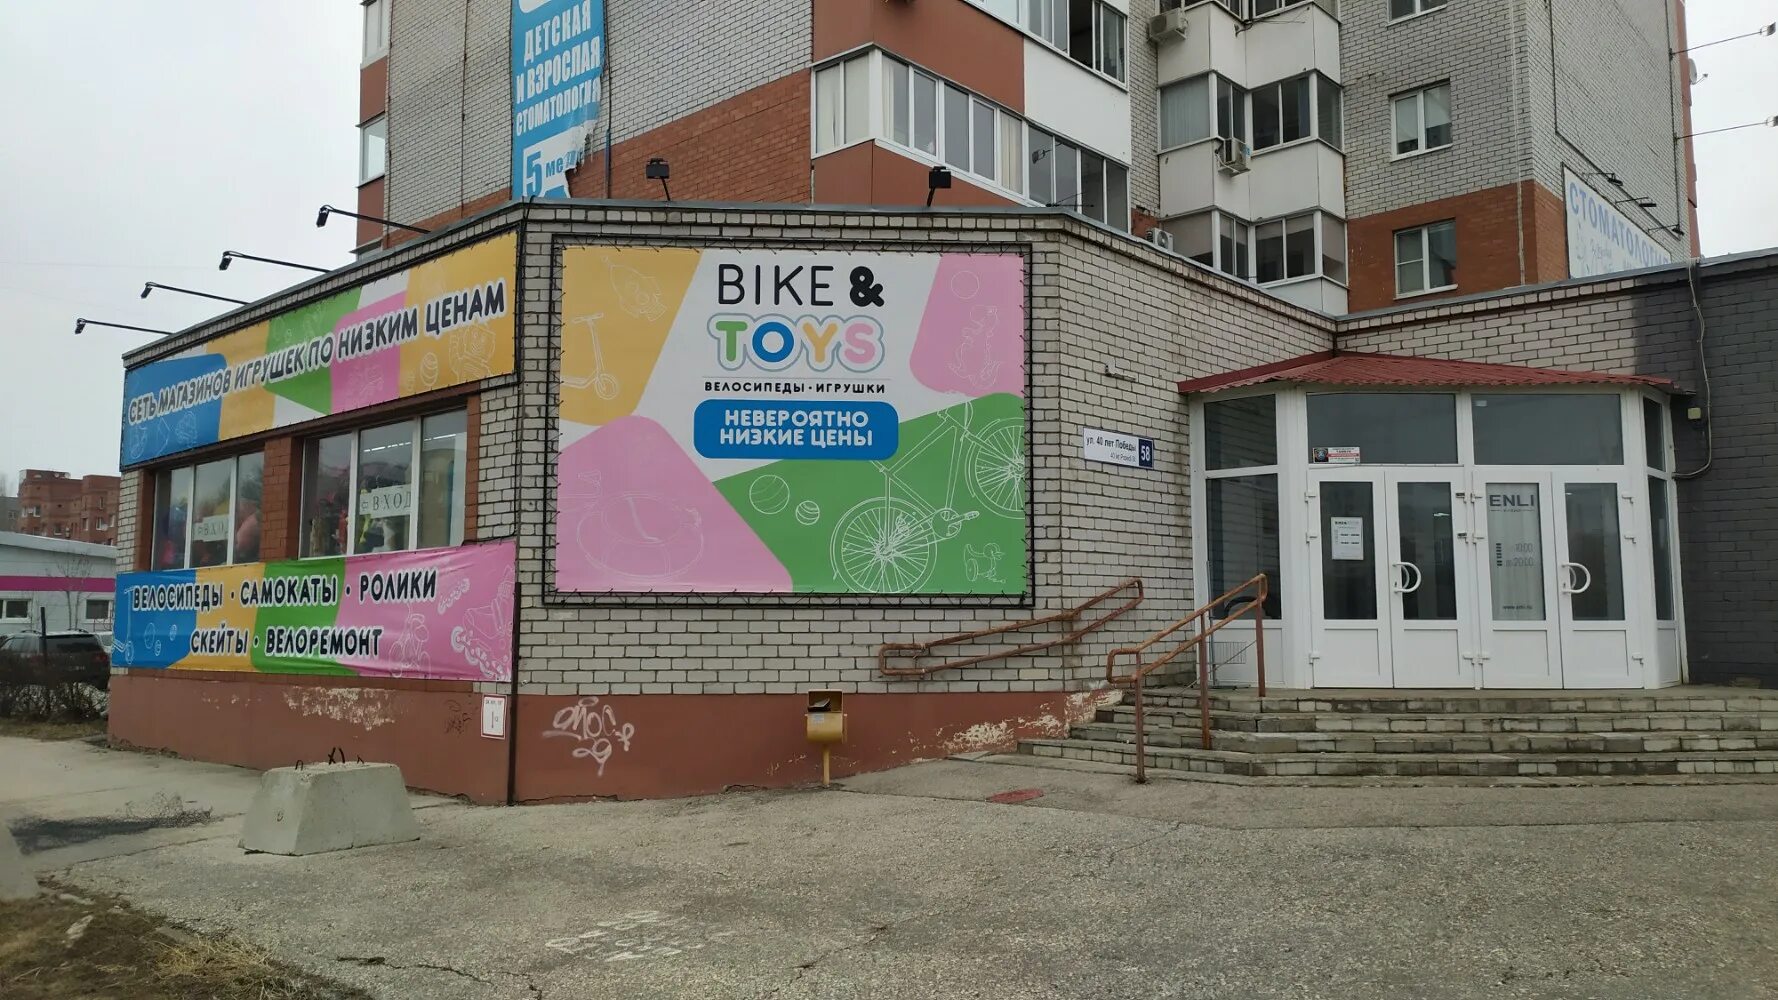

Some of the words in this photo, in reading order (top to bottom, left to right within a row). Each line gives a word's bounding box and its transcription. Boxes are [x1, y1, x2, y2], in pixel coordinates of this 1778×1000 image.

[524, 0, 591, 67] ДЕТСКАЯ
[516, 73, 524, 104] И
[527, 36, 600, 99] ВЗРОСЛАЯ
[516, 76, 601, 137] СТОМАТОЛОГИЯ
[526, 150, 542, 198] 5
[718, 264, 834, 306] BIKE
[850, 266, 885, 307] &
[129, 396, 156, 424] СЕТЬ
[158, 369, 231, 413] МАГАЗИНОВ
[234, 342, 305, 389] ИГРУШЕК
[308, 337, 333, 368] ПО
[338, 308, 418, 359] НИЗКИМ
[425, 282, 505, 335] ЦЕНАМ
[715, 320, 876, 365] TOYS
[704, 381, 805, 394] ВЕЛОСИПЕДЫ
[816, 383, 885, 394] ИГРУШКИ
[720, 428, 804, 446] НИЗКИЕ
[811, 429, 873, 448] ЦЕНЫ
[725, 409, 869, 427] НЕВЕРОЯТНО
[1096, 436, 1104, 446] 40
[1104, 439, 1114, 448] лет
[1115, 439, 1137, 452] Победы
[1140, 445, 1151, 462] 58
[1489, 494, 1535, 507] ENLI
[133, 584, 223, 612] ВЕЛОСИПЕДЫ
[240, 575, 337, 605] САМОКАТЫ
[360, 570, 437, 601] РОЛИКИ
[191, 623, 248, 654] СКЕЙТЫ
[266, 629, 383, 656] ВЕЛОРЕМОНТ
